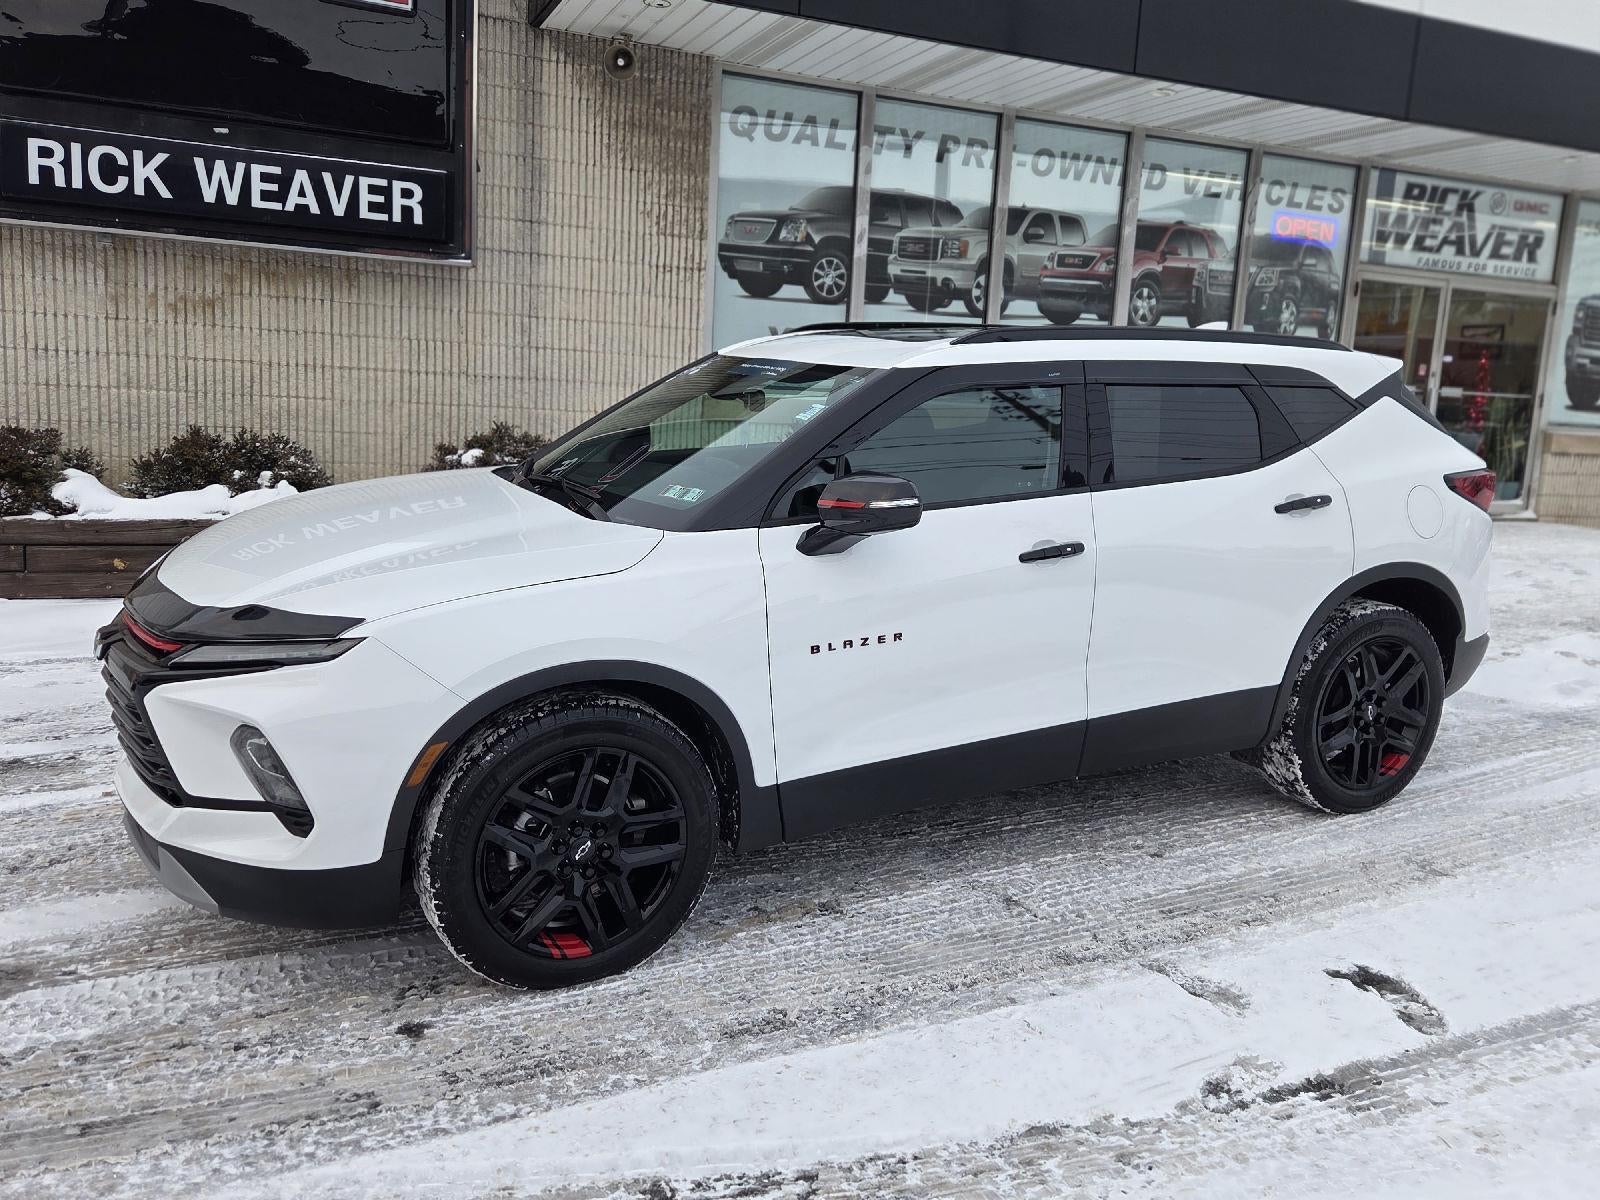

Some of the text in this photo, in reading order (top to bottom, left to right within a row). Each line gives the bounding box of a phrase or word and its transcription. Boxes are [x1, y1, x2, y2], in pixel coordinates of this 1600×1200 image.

[728, 105, 925, 159] QUALTY
[936, 133, 1168, 191] PR-OWND
[27, 137, 424, 225] RICK WEAVER
[1400, 181, 1549, 218] RICK GMC
[1276, 216, 1335, 241] OPEN
[1374, 208, 1545, 264] WEAVER
[1417, 257, 1539, 278] FAMOUS FOR SERVICE
[810, 632, 903, 654] BLAZER
